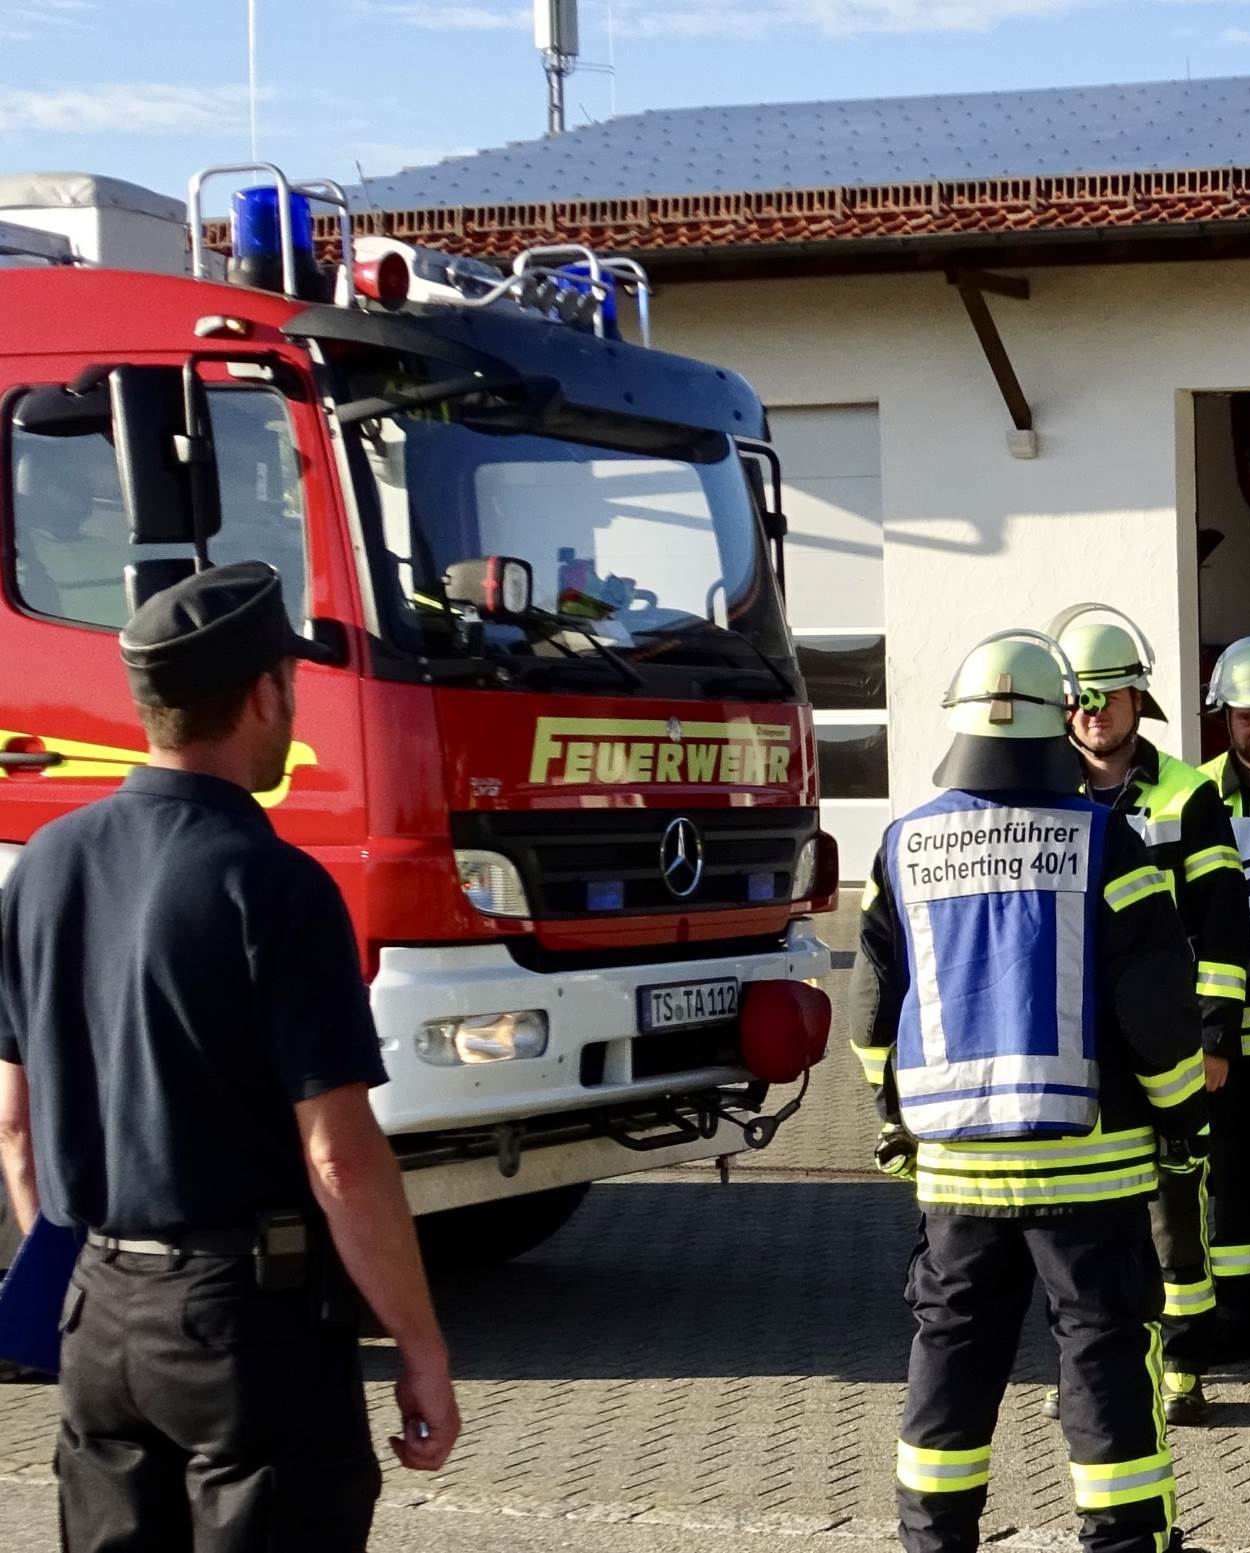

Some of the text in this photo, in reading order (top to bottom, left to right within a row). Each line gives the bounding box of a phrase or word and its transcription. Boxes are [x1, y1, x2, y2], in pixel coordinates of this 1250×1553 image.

[529, 717, 790, 784] FEUERWEHR
[907, 821, 1080, 855] Gruppenführer
[907, 851, 1078, 886] Tacherting 40/1
[653, 992, 674, 1023] TS
